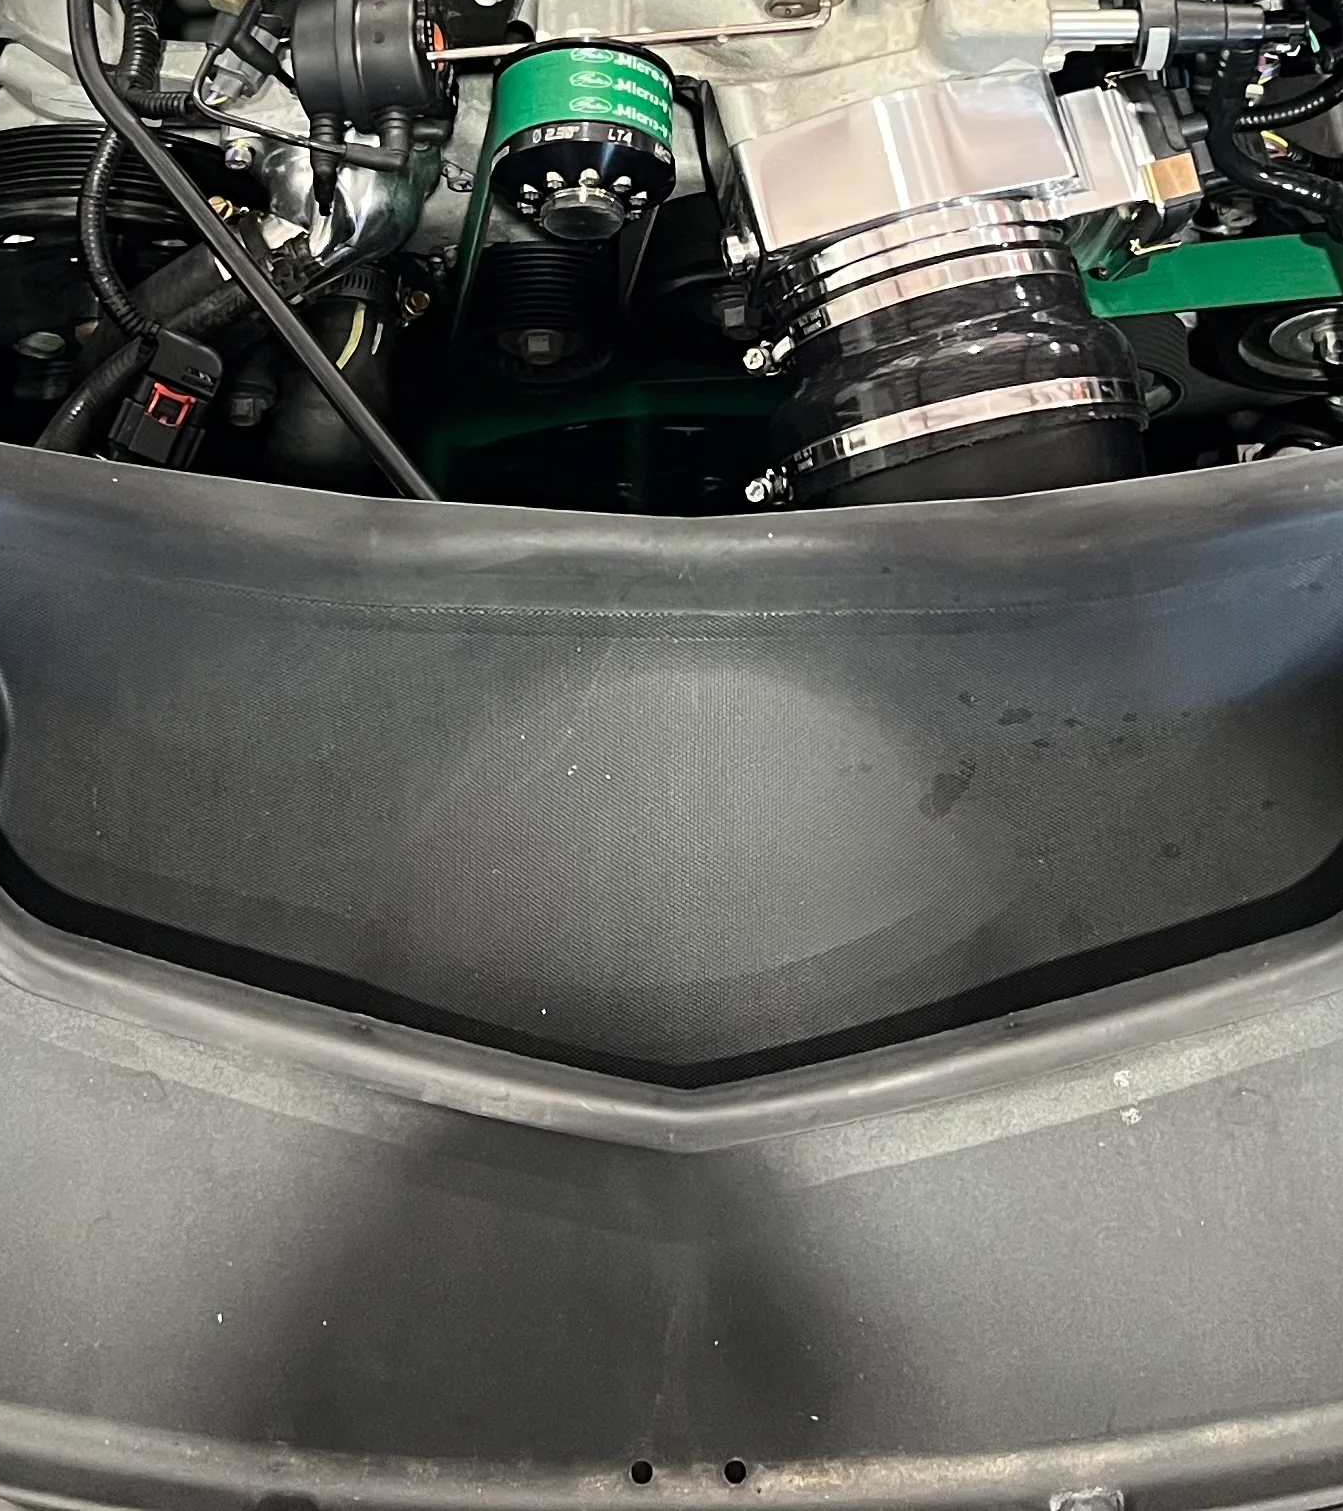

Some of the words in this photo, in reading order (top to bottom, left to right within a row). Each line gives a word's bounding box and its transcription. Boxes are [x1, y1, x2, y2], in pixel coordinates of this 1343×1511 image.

[613, 78, 669, 114] Micro-V
[607, 128, 633, 145] LT4
[612, 103, 668, 139] Micro-V
